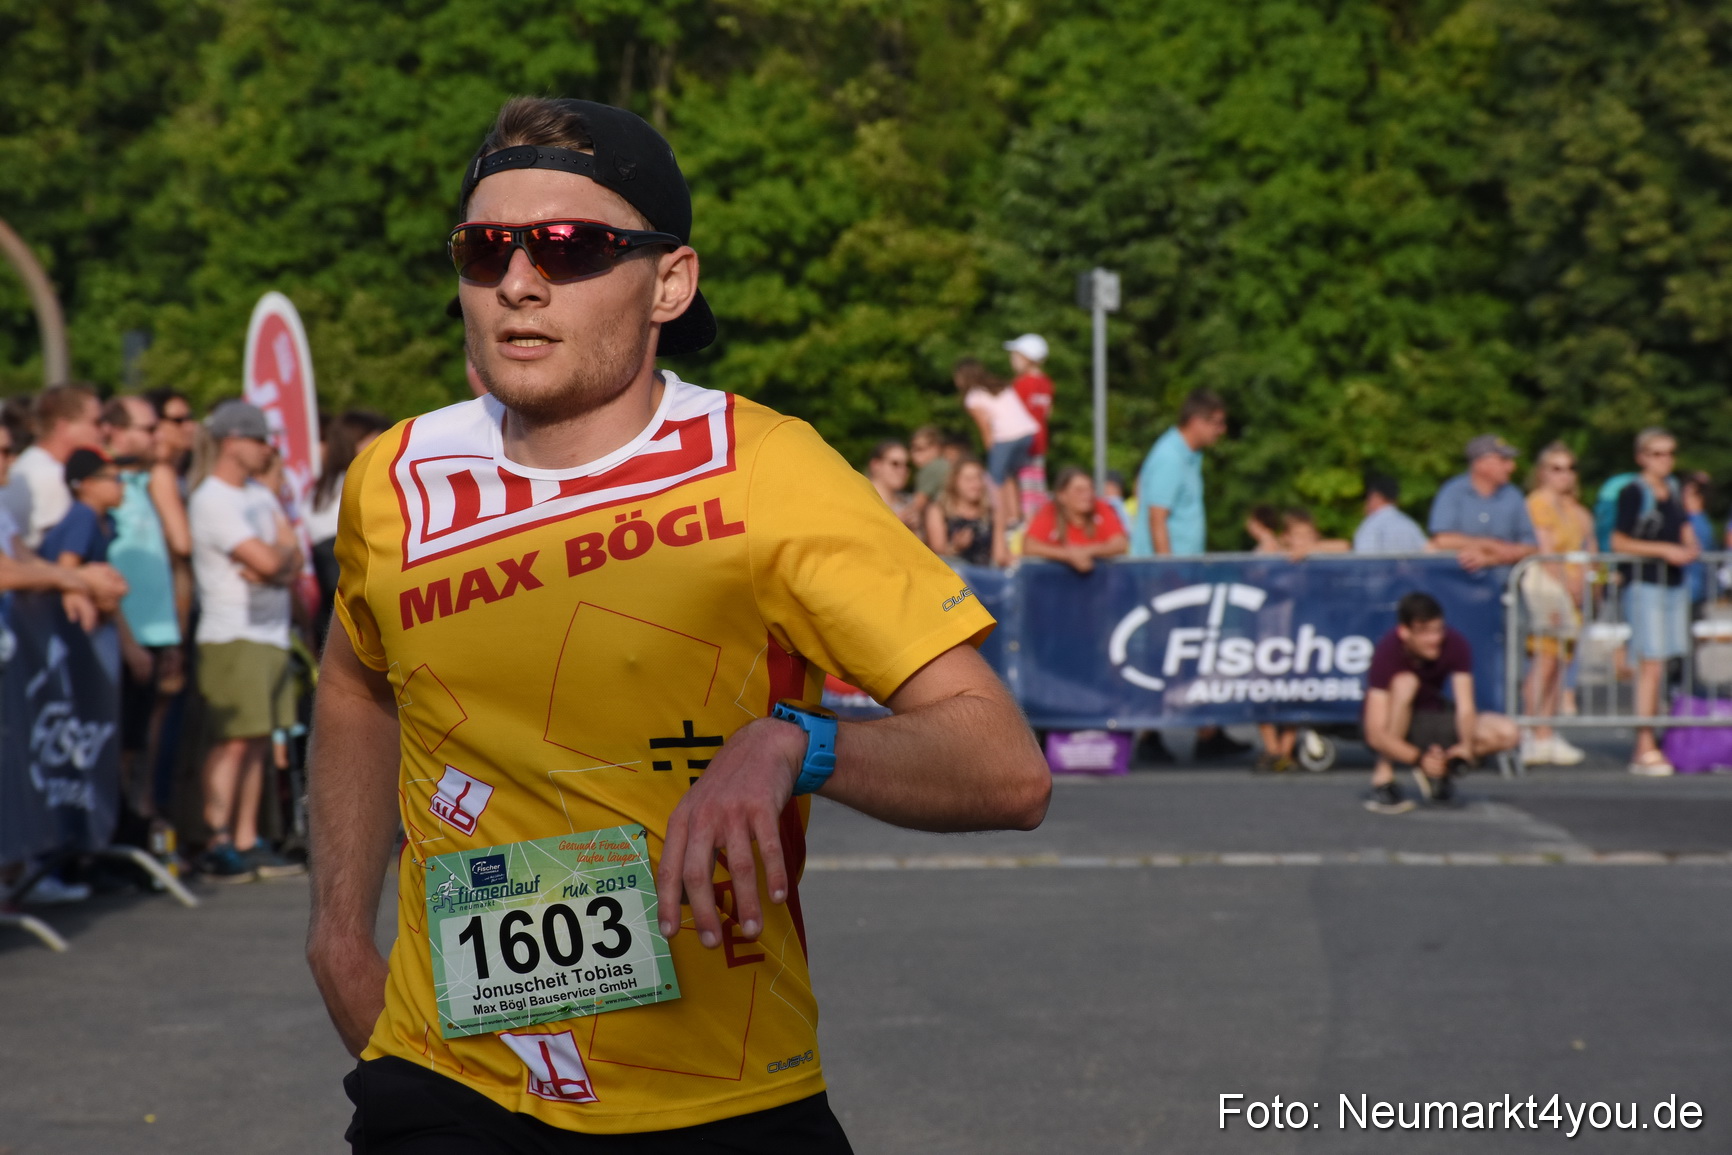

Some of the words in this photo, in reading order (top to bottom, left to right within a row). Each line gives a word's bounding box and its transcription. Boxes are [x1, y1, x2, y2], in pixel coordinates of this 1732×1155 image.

[399, 549, 544, 631] MAX
[564, 497, 746, 578] BÖGL
[1163, 624, 1374, 676] Fische
[1186, 677, 1364, 702] AUTOMOBIL
[559, 839, 596, 851] Gesunde
[599, 839, 630, 850] Firmen
[477, 864, 500, 873] Fischer
[577, 852, 604, 865] laufen
[607, 851, 641, 867] länger!
[458, 874, 541, 904] firmenlauf
[562, 882, 589, 898] run
[596, 875, 636, 893] 2019
[459, 899, 496, 911] neumarkt
[458, 896, 632, 979] 1603
[472, 972, 568, 1001] Jonuscheit
[571, 963, 633, 984] Tobias
[473, 1004, 497, 1016] Max
[499, 998, 527, 1011] Bögl
[529, 987, 596, 1006] Bauservice
[600, 978, 638, 993] GmbH
[767, 1050, 813, 1073] owayo
